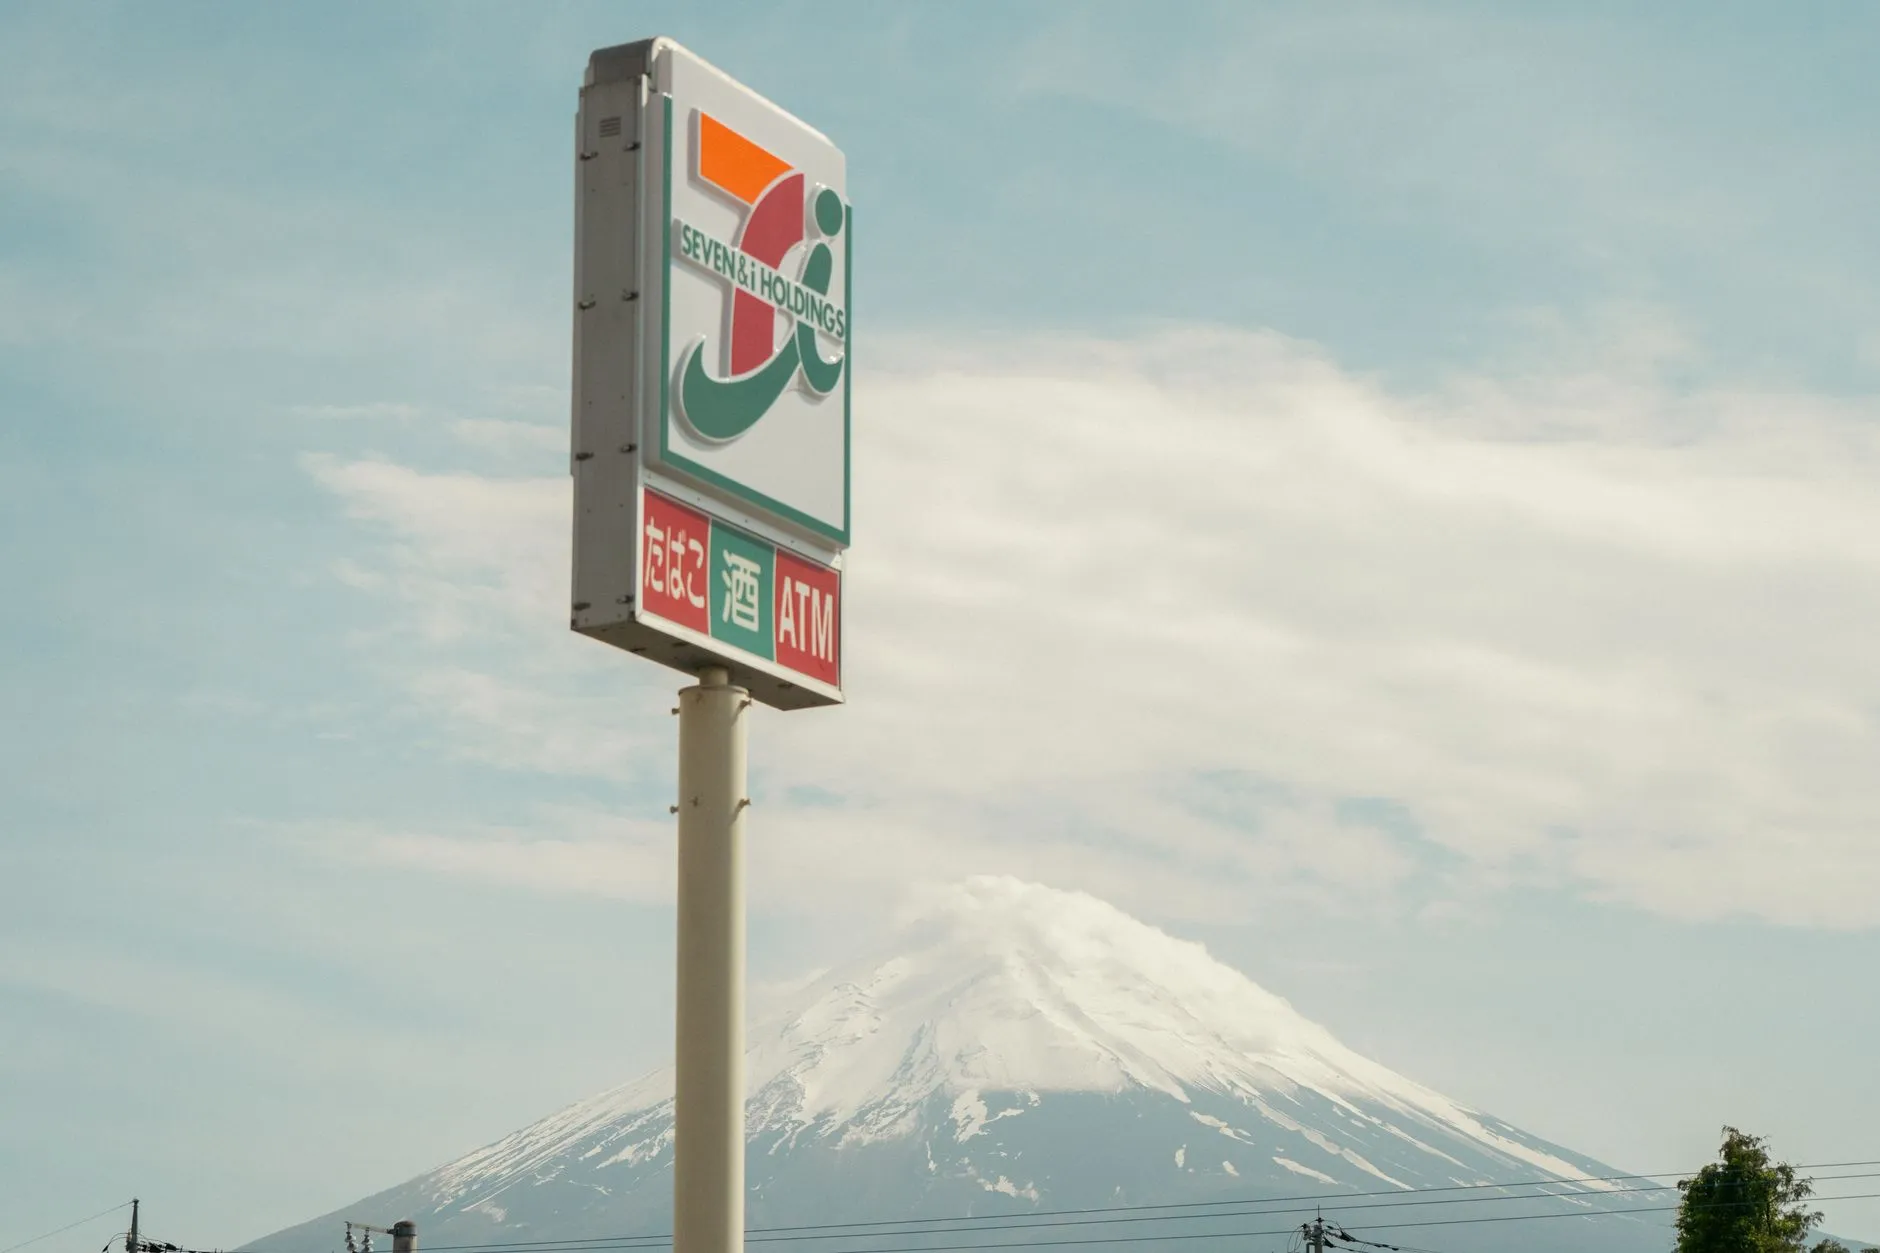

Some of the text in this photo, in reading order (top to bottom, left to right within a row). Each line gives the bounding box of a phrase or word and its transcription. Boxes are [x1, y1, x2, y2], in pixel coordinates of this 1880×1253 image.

[760, 267, 845, 338] HOLDINGS
[645, 516, 705, 609] たばこ
[722, 549, 761, 633] 酒
[779, 576, 834, 663] ATM
